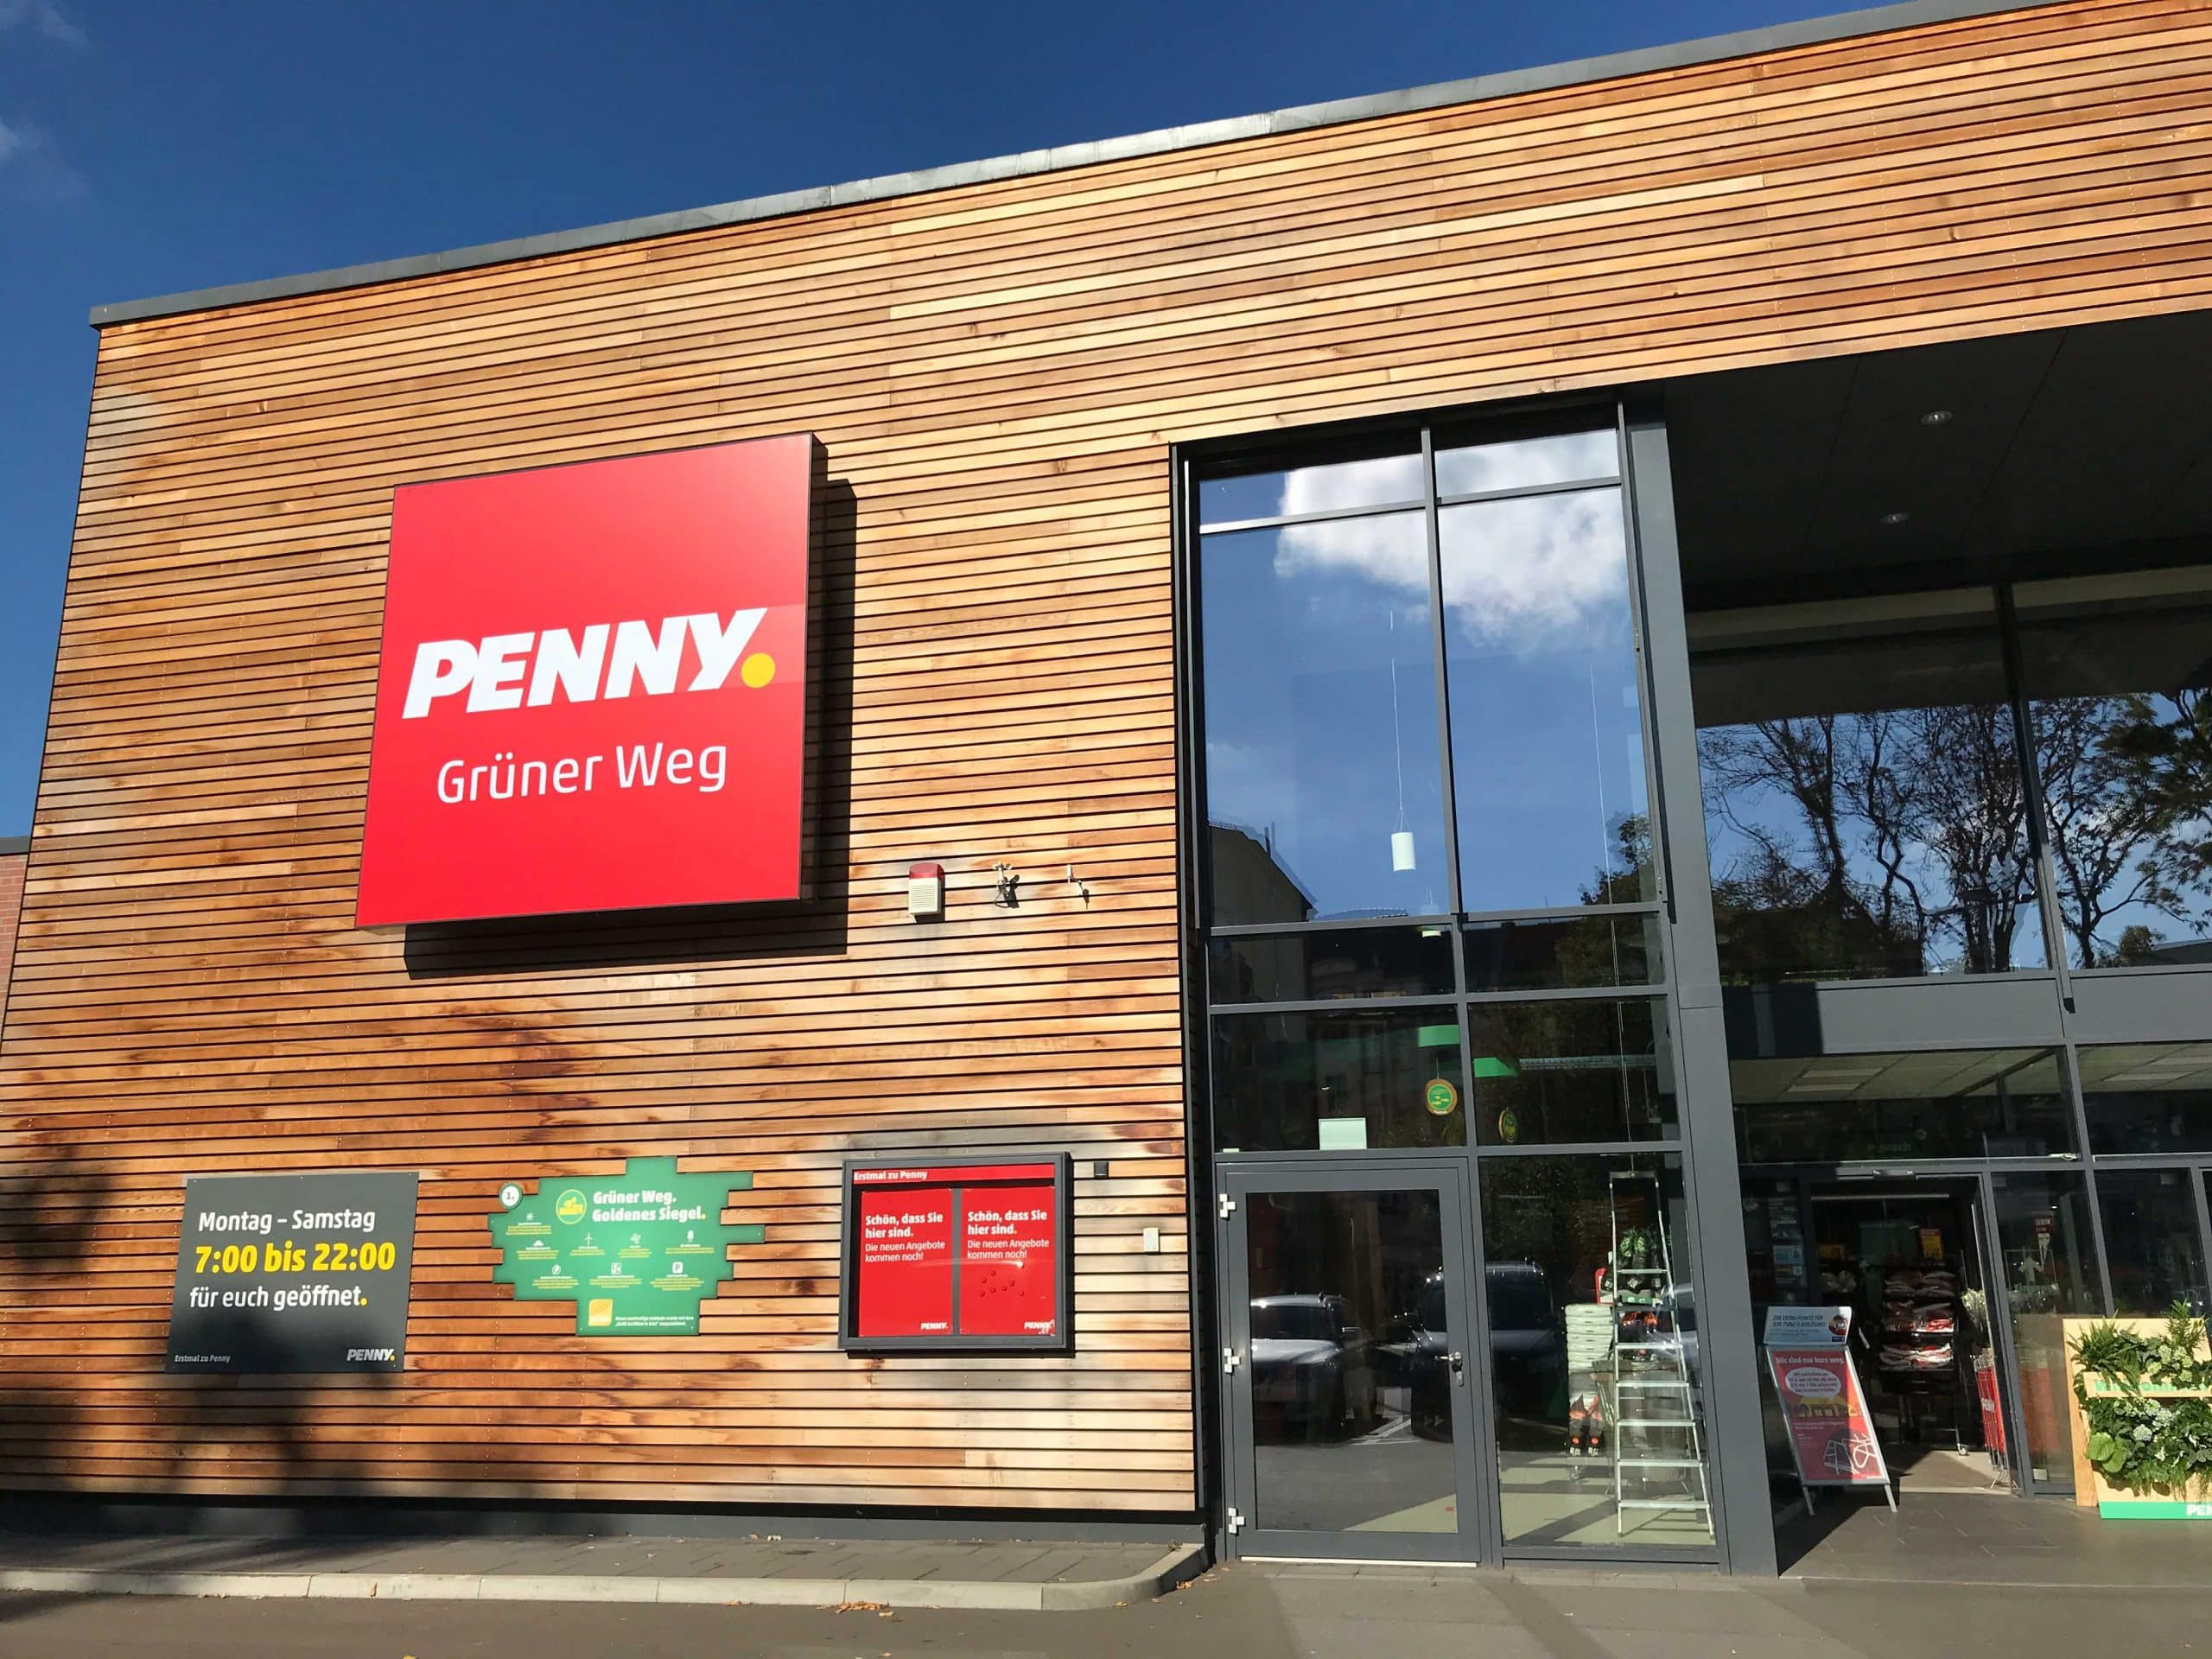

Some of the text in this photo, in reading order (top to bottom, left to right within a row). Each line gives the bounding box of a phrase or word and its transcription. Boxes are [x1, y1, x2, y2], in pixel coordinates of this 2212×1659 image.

[437, 742, 727, 804] Grüner Weg
[854, 1170, 927, 1181] Erstmal zu Penny
[593, 1190, 677, 1205] Grüner Weg.
[592, 1205, 706, 1223] Goldenes Siegel.
[865, 1211, 944, 1226] Schön, dass Sie
[968, 1210, 1047, 1223] Schön, dass Sie
[198, 1211, 272, 1235] Montag
[291, 1209, 376, 1232] Samstag
[865, 1226, 914, 1238] hier sind.
[968, 1224, 1018, 1235] hier sind.
[865, 1243, 878, 1252] Die
[906, 1241, 945, 1253] Angebote
[968, 1239, 981, 1249] Die
[1009, 1238, 1049, 1250] Angebote
[195, 1240, 396, 1274] 7:00 bis 22:00
[865, 1251, 924, 1262] kommen noch!
[968, 1250, 1027, 1259] kommen noch!
[189, 1285, 367, 1311] für euch geöffnet.
[210, 1354, 231, 1363] Penny
